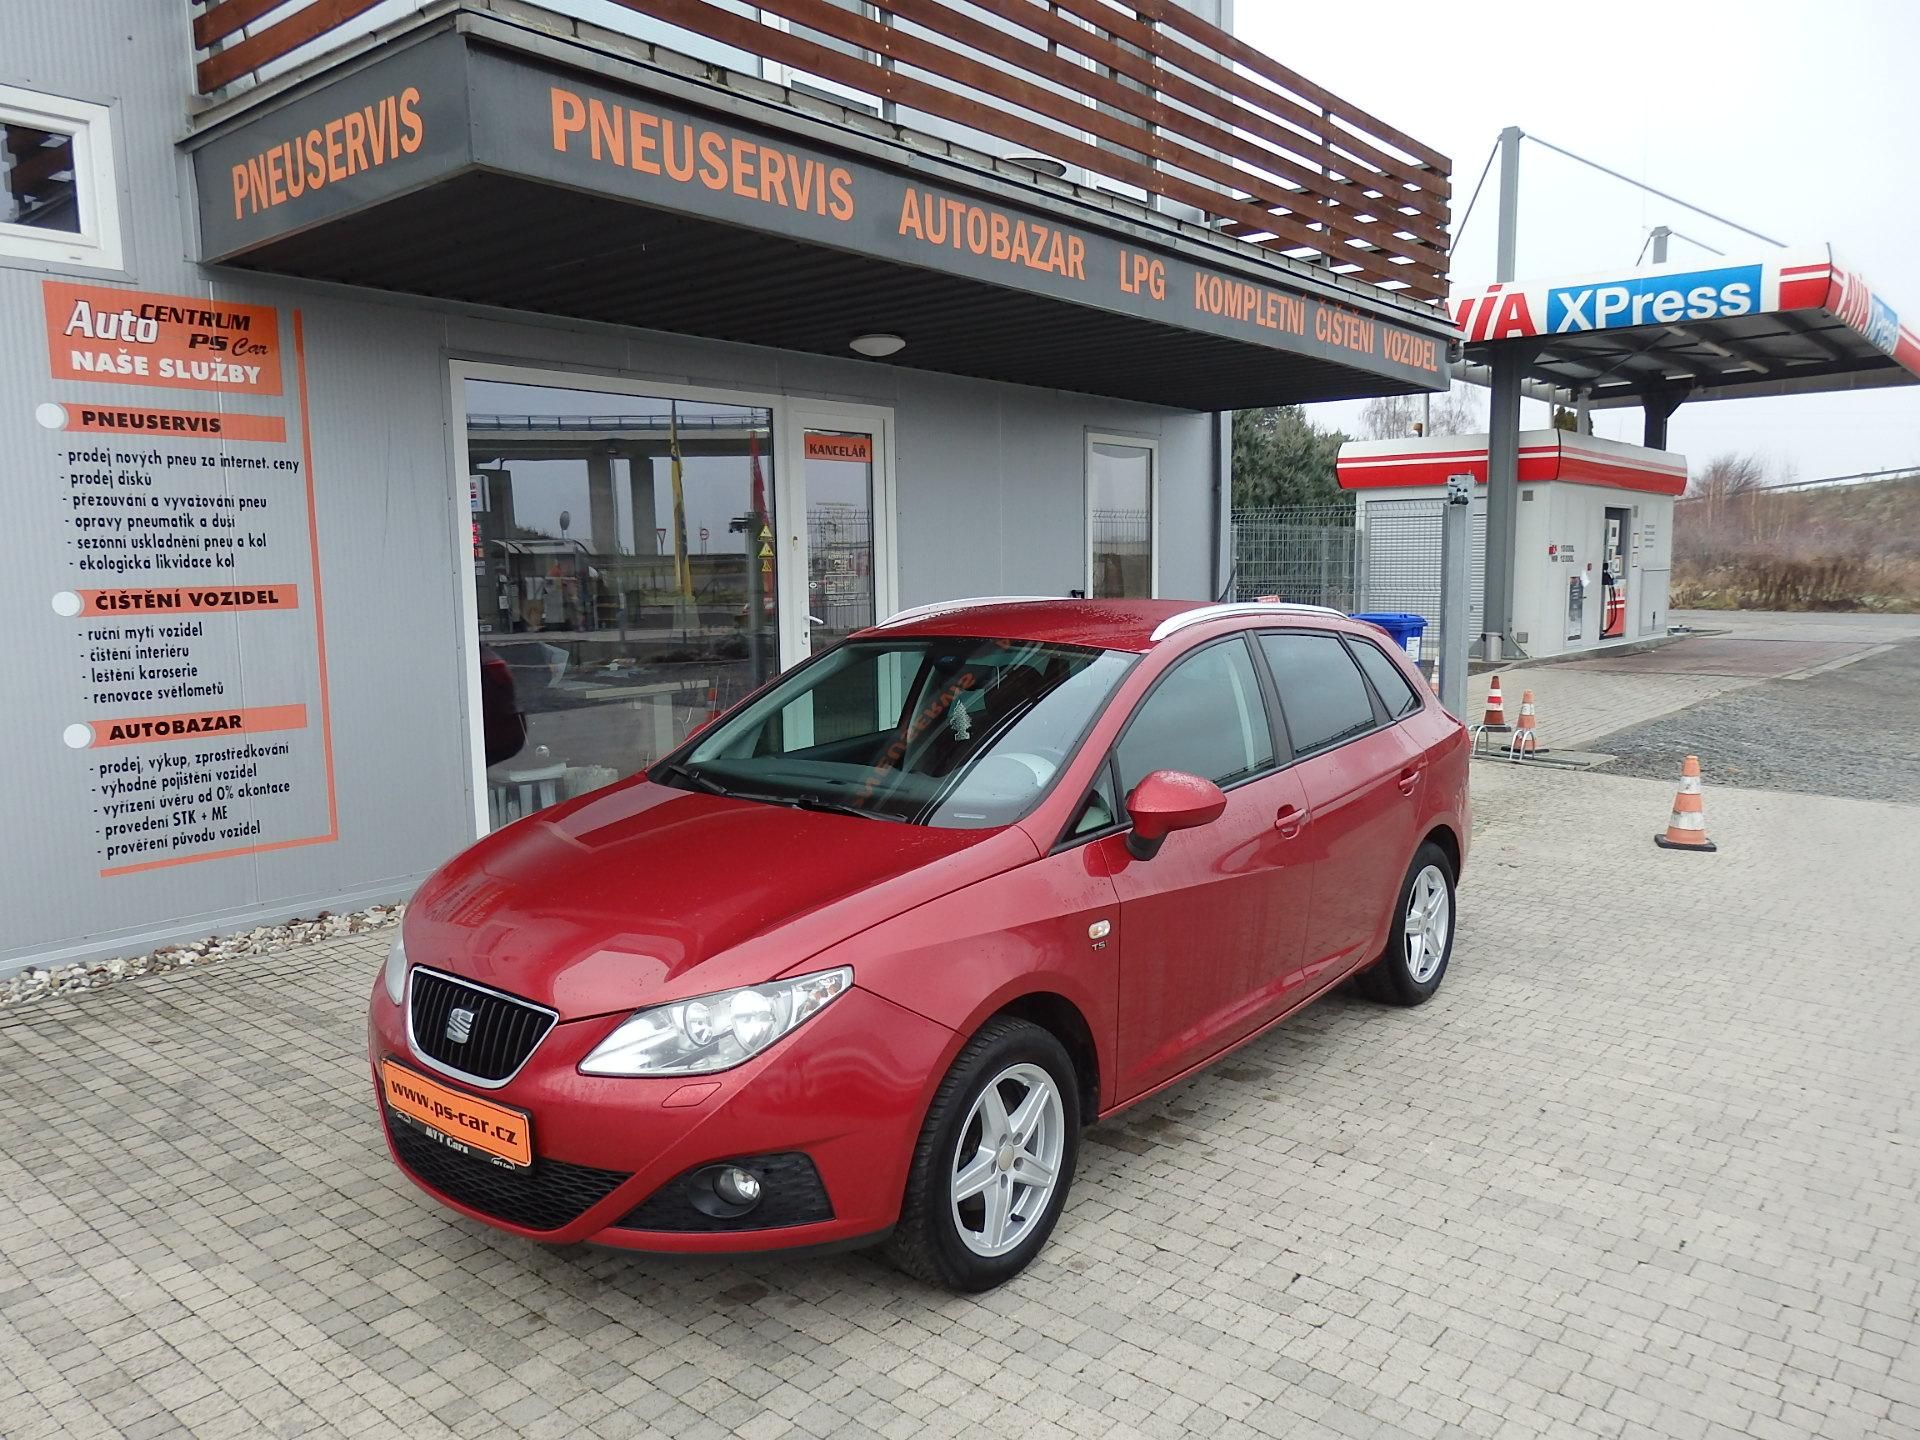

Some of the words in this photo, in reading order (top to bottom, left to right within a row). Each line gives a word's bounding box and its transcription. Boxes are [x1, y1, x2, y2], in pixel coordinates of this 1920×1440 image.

[231, 87, 424, 221] PNEUSERVIS
[549, 87, 855, 222] PNEUSERVIS
[898, 187, 1087, 281] AUTOBAZAR
[1119, 249, 1166, 301] LPG
[1194, 271, 1307, 336] KOMPLETNÍ
[1383, 327, 1438, 372] VOZIDEL
[1554, 282, 1753, 334] XPress
[63, 299, 160, 344] Auto
[140, 303, 251, 331] CENTRUM
[188, 333, 229, 352] PS
[231, 337, 269, 357] Car
[71, 348, 150, 376] NAŠE
[159, 357, 261, 385] SLUŽBY
[81, 410, 222, 433] PNEUSERVIS
[68, 447, 111, 467] prodej
[116, 449, 162, 468] nových
[167, 455, 197, 469] pneu
[201, 456, 215, 467] za
[220, 453, 270, 469] internet.
[273, 460, 300, 474] ceny
[809, 443, 867, 458] KANCELÁŘ
[70, 469, 114, 489] prodej
[118, 469, 152, 486] disků
[73, 492, 147, 510] přezouvání
[151, 497, 159, 507] a
[164, 494, 235, 511] vyvažování
[239, 498, 267, 512] pneu
[75, 517, 122, 532] opravy
[127, 512, 195, 532] pneumatik
[200, 517, 207, 528] a
[212, 512, 236, 528] duší
[77, 534, 127, 549] sezónní
[131, 533, 200, 549] uskladnění
[204, 537, 233, 551] pneu
[237, 537, 244, 548] a
[248, 532, 267, 548] kol
[80, 554, 151, 574] ekologická
[156, 553, 212, 569] likvidace
[216, 552, 235, 568] kol
[95, 589, 181, 610] ČIŠTĚNÍ
[188, 590, 279, 607] VOZIDEL
[88, 626, 120, 641] ruční
[158, 621, 203, 638] vozidel
[90, 646, 132, 662] čištění
[135, 643, 190, 660] interiéru
[91, 666, 135, 682] leštění
[139, 662, 198, 680] karoserie
[93, 687, 153, 704] renovace
[157, 681, 224, 699] světlometů
[109, 714, 243, 741] AUTOBAZAR
[99, 756, 144, 778] prodej,
[149, 752, 191, 773] výkup,
[195, 741, 289, 767] zprostředkování
[102, 775, 157, 799] výhodné
[162, 769, 212, 791] pojištění
[215, 762, 257, 781] vozidel
[103, 794, 156, 819] vyřízení
[160, 793, 194, 809] úvěru
[198, 787, 213, 804] od
[217, 784, 234, 801] 0%
[238, 782, 291, 799] akontace
[105, 814, 169, 840] provedení
[173, 809, 197, 827] STK
[211, 805, 228, 821] ME
[107, 834, 169, 861] prověření
[172, 827, 216, 850] původu
[220, 820, 261, 838] vozidel
[391, 1080, 518, 1145] www.ps-car.cz
